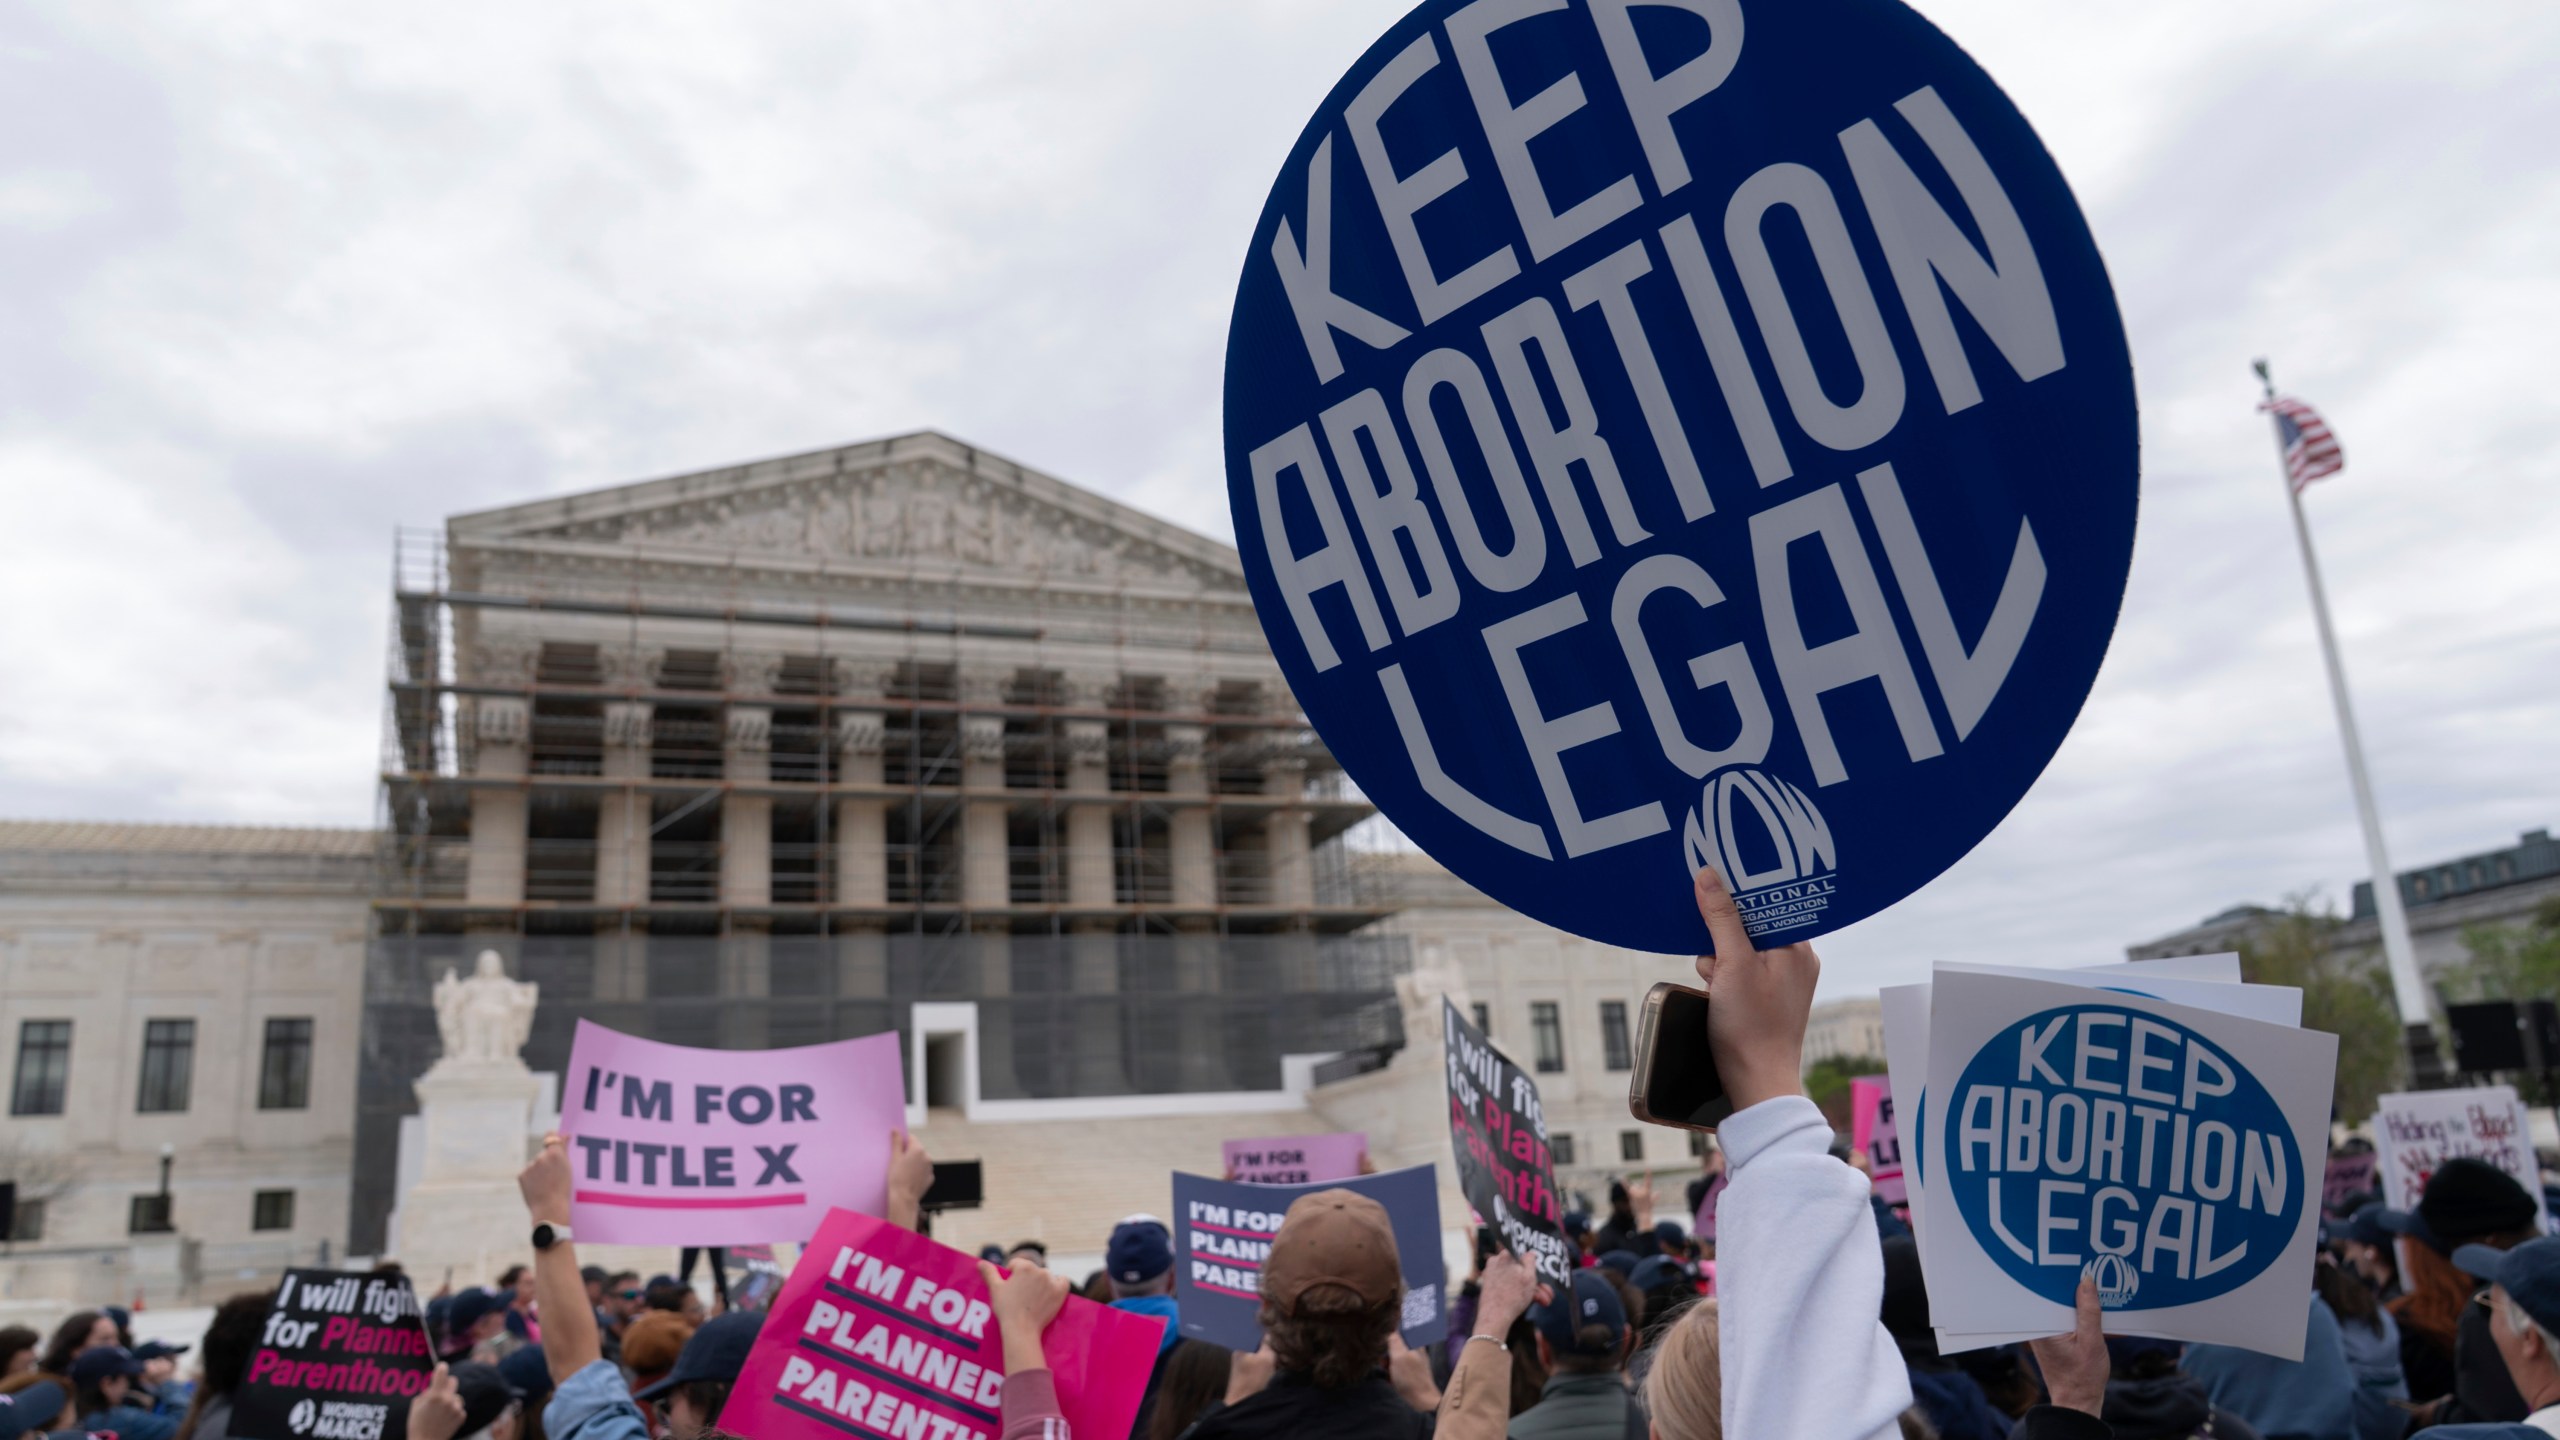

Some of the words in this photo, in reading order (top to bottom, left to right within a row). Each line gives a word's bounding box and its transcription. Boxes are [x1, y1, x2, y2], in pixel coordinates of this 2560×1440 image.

[1271, 0, 1744, 385] KEEP
[1248, 84, 2067, 673] ABORTION
[1376, 461, 2048, 861] LEGAL
[1683, 769, 1837, 894] NOW
[1735, 879, 1836, 911] ATIONAL
[1741, 896, 1828, 923] RGANIZATION
[1747, 922, 1769, 935] FOR
[1772, 912, 1818, 929] WOMEN
[583, 1066, 672, 1122] I'M
[695, 1083, 819, 1125] FOR
[1459, 1030, 1502, 1099] will
[1511, 1075, 1547, 1141] fig
[2018, 1012, 2237, 1111] KEEP
[1447, 1050, 1480, 1116] for
[1484, 1096, 1554, 1177] Plan
[1959, 1084, 2287, 1217] ABORTION
[576, 1134, 736, 1187] TITLE
[754, 1143, 804, 1187] X
[1268, 1150, 1306, 1165] FOR
[1451, 1094, 1560, 1228] Parenth
[1189, 1201, 1229, 1226] I'M
[1234, 1208, 1285, 1233] FOR
[1190, 1230, 1274, 1262] PLANN
[1988, 1177, 2248, 1280] LEGAL
[262, 1312, 318, 1349] for
[320, 1316, 428, 1357] Planne
[277, 1274, 298, 1309] I
[300, 1278, 361, 1314] will
[362, 1279, 420, 1324] figh
[828, 1246, 905, 1302] I'M
[904, 1276, 992, 1339] FOR
[802, 1299, 1005, 1408] PLANNED
[312, 1419, 384, 1440] MARCH
[320, 1401, 389, 1422] WOMEN'S
[777, 1355, 988, 1440] PARENTH
